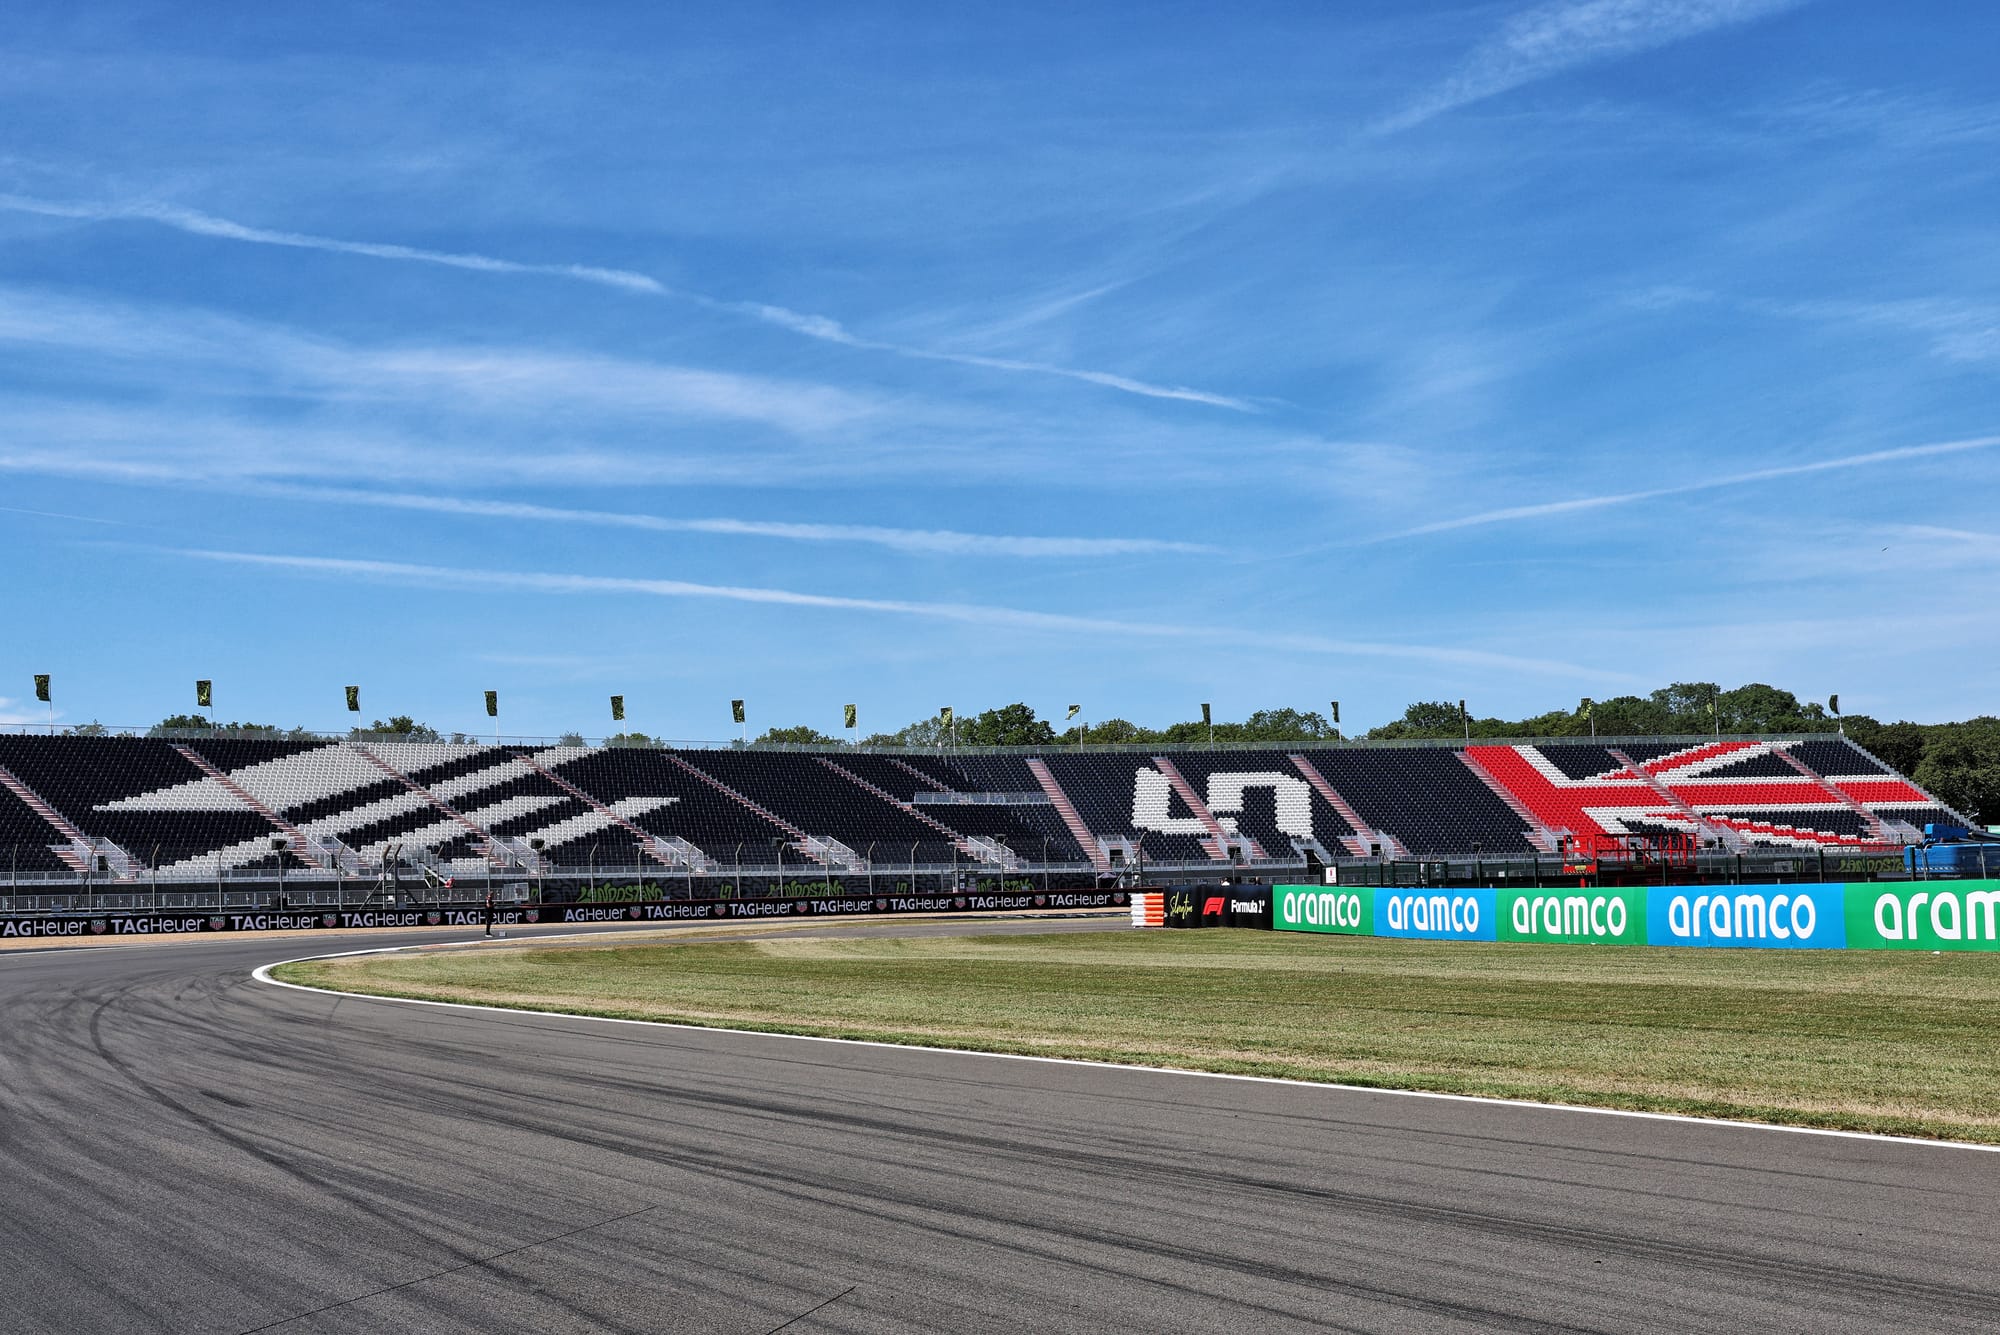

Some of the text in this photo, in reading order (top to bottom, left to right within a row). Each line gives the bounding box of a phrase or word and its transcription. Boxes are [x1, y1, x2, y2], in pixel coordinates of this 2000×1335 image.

[1231, 899, 1257, 913] Formula
[1283, 892, 1361, 927] aramco
[1387, 896, 1479, 933] aramco
[1512, 896, 1626, 937] aramco
[1668, 894, 1816, 939] aramco
